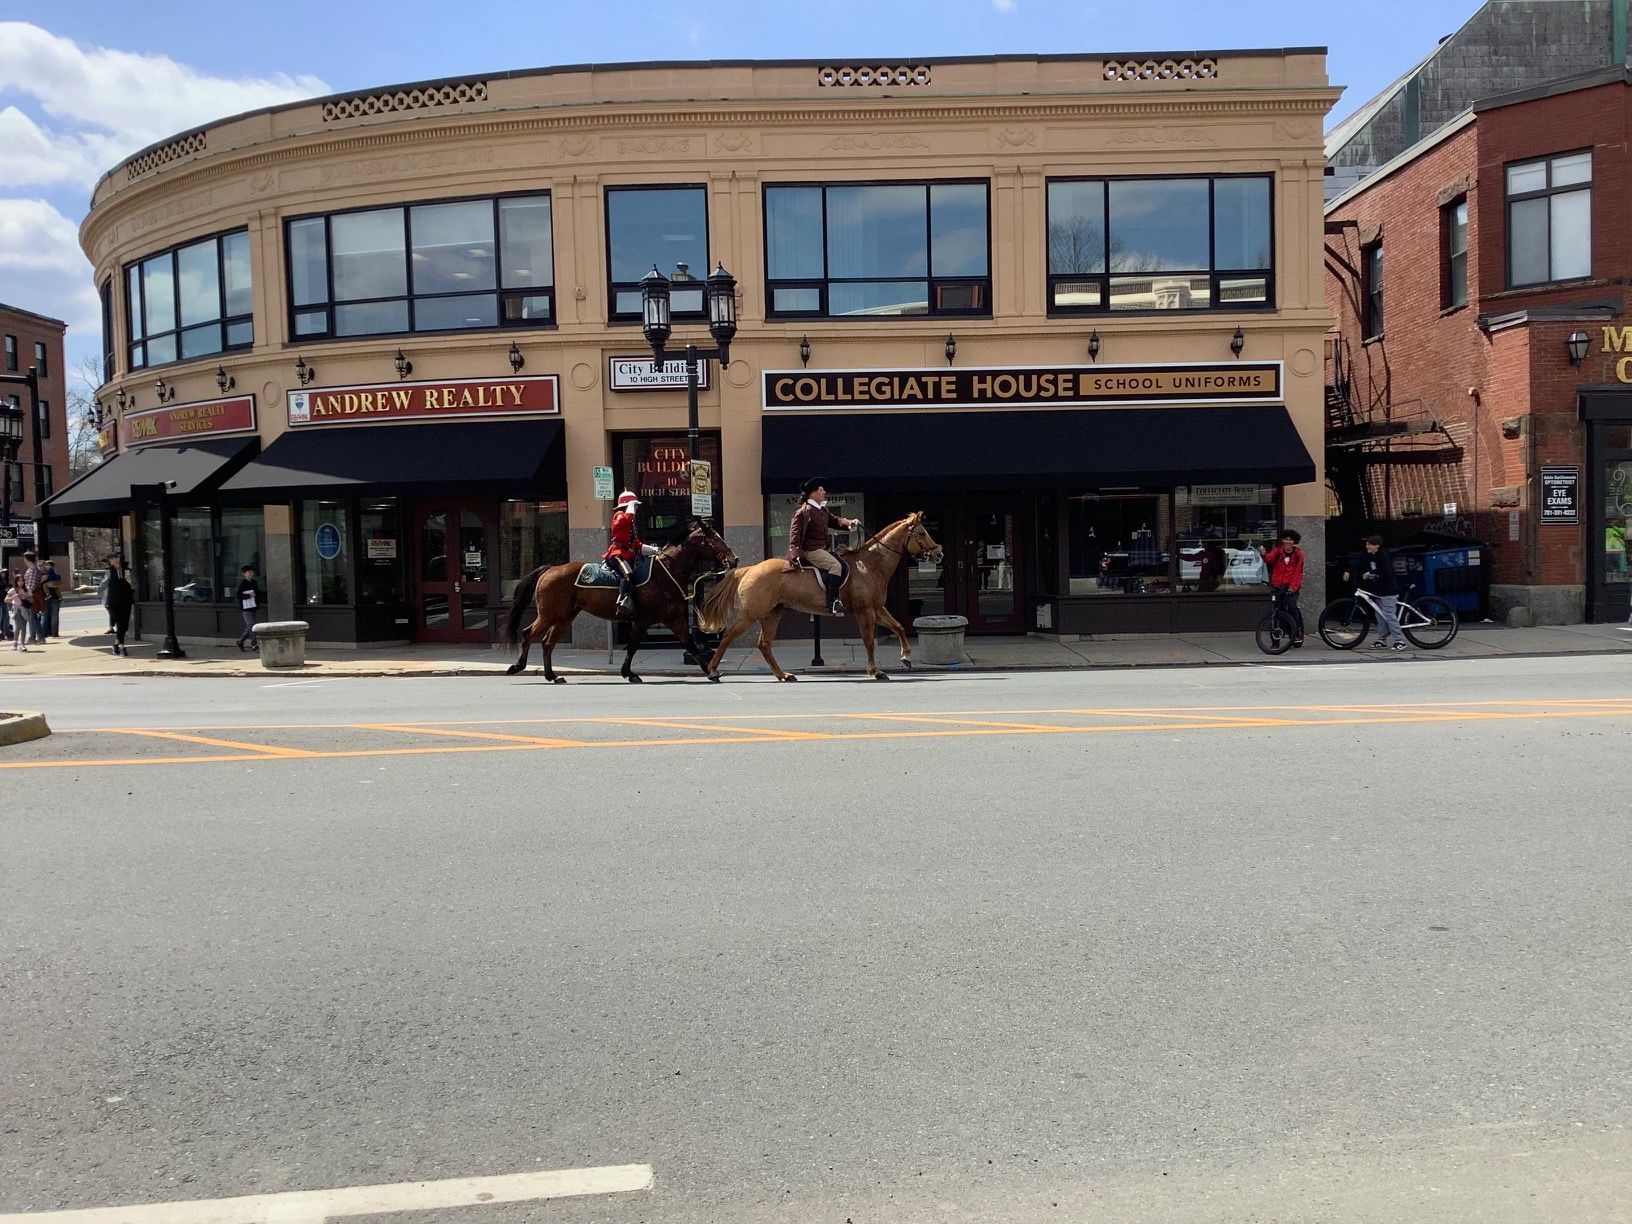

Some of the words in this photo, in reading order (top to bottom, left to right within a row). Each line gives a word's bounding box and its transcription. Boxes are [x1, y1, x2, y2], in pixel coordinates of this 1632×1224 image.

[619, 363, 644, 376] City
[661, 375, 688, 383] STREET
[1094, 377, 1164, 390] SCHOOL
[1172, 375, 1262, 389] UNIFORMS
[774, 376, 958, 401] COLLEGIATE
[972, 373, 1074, 399] HOUSE
[313, 389, 413, 417] ANDREW
[424, 384, 526, 410] REALTY
[169, 408, 196, 422] ANDREW
[200, 405, 225, 418] REALTY
[179, 419, 214, 432] SERVICES
[654, 448, 687, 460] CITY
[667, 477, 678, 487] 10
[640, 488, 666, 497] HIGH
